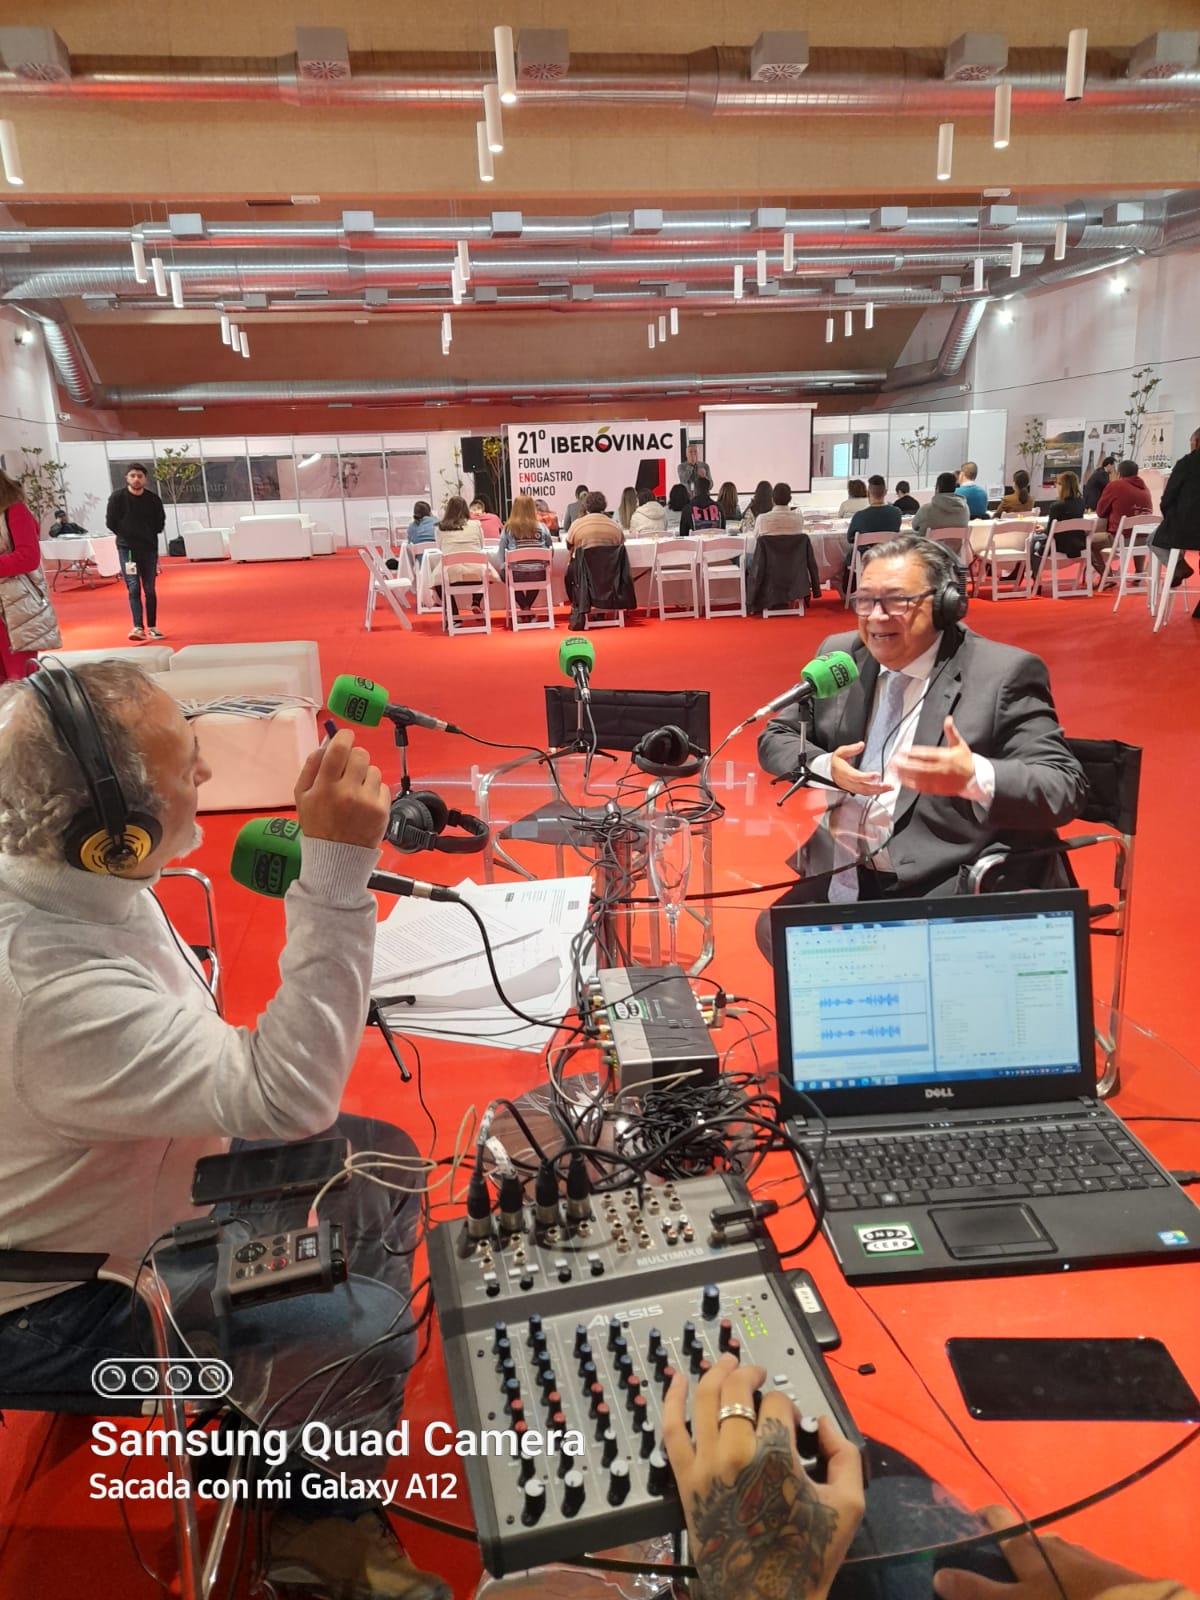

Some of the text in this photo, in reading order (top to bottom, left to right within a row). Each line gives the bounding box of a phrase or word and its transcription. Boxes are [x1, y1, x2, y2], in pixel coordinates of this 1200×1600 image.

[518, 457, 550, 469] FORUM
[519, 471, 573, 483] ENOGASTRO
[925, 1087, 955, 1098] DELL
[865, 1230, 905, 1241] ONDA
[872, 1240, 909, 1249] CERO
